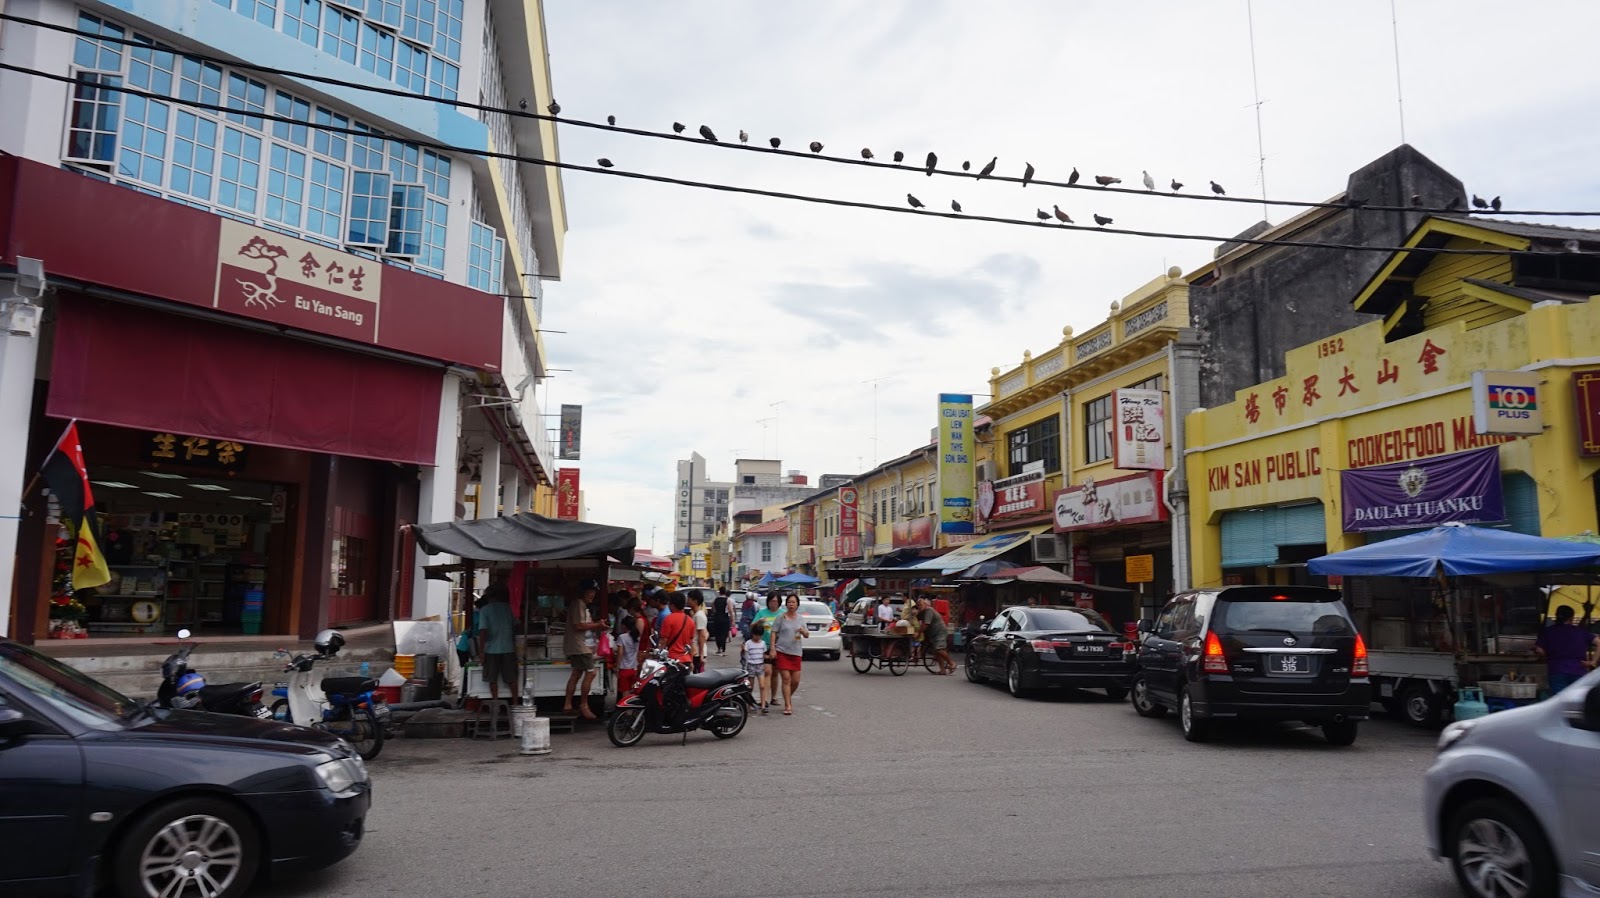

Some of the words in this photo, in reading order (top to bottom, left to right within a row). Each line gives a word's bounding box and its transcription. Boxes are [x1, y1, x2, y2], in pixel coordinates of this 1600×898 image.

[298, 251, 366, 292] 余仁生
[295, 295, 310, 311] Eu
[312, 300, 333, 316] Yan
[334, 305, 364, 326] Sang
[1317, 338, 1345, 359] 1952
[1495, 387, 1530, 409] 100
[943, 409, 956, 417] KEDAI
[957, 409, 970, 417] UBAT
[1497, 410, 1530, 419] PLUS
[950, 420, 963, 429] LIEW
[951, 431, 962, 440] WAN
[950, 443, 963, 452] THYE
[1208, 466, 1230, 493] KIM
[1235, 459, 1261, 488] SAN
[1267, 447, 1321, 482] PUBLIC
[680, 480, 689, 528] HOTEL
[1355, 503, 1413, 521] DAULAT
[1412, 496, 1483, 517] TUANKU
[1281, 656, 1297, 664] JJC
[1282, 664, 1297, 672] 515
